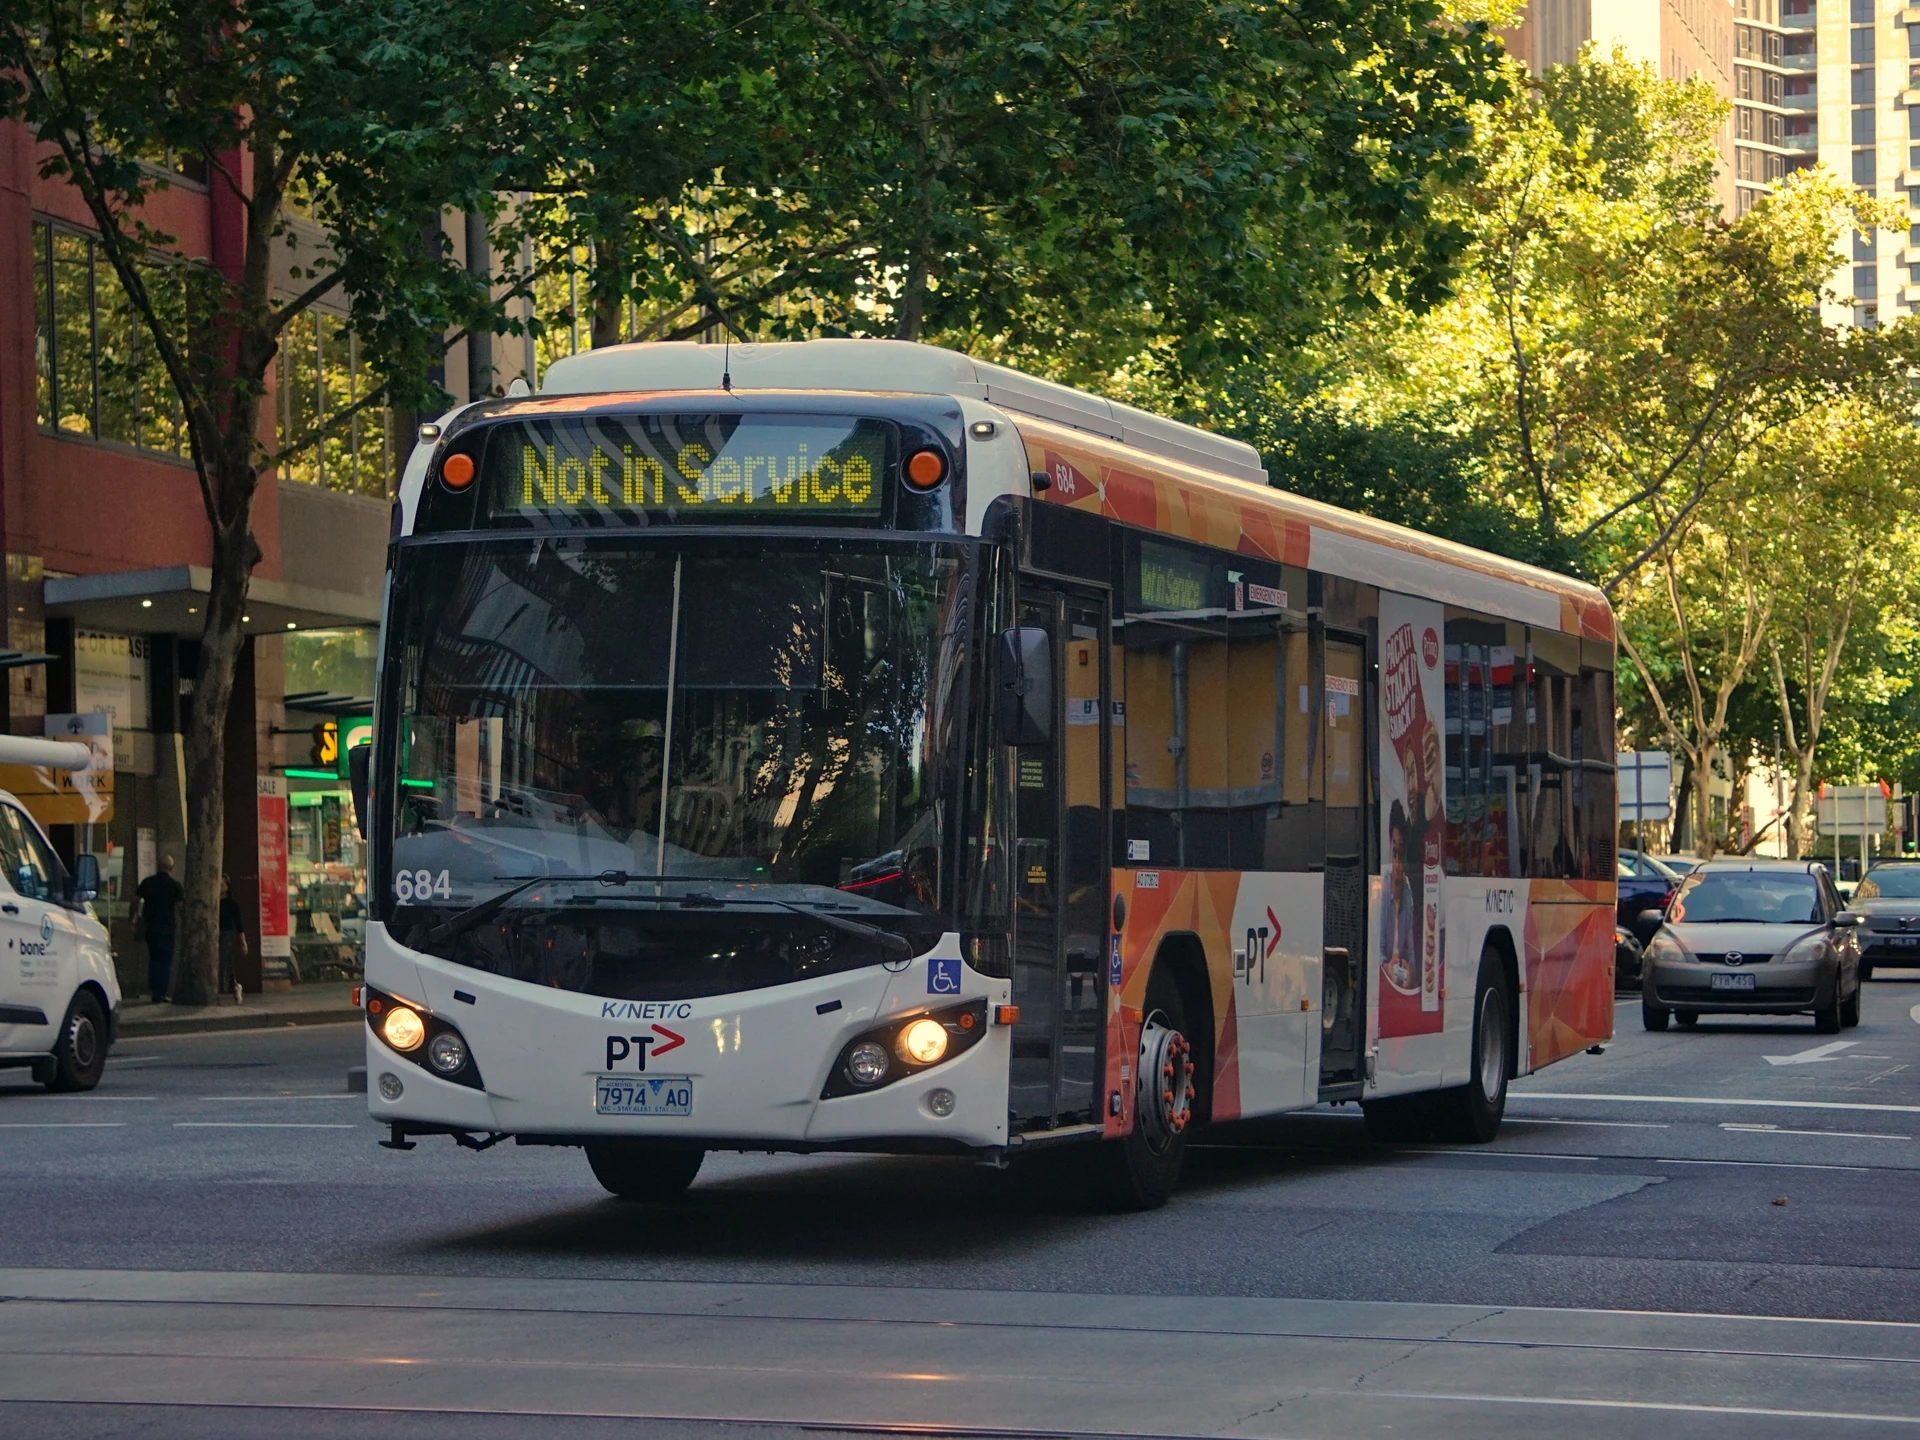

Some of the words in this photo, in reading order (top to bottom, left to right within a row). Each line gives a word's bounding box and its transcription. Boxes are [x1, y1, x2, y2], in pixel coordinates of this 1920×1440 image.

[523, 444, 609, 504] Not
[623, 444, 663, 504] in
[677, 443, 873, 504] Service
[1055, 464, 1076, 495] 684
[1250, 586, 1276, 604] EMERGENCY
[1385, 628, 1406, 671] PACK
[1385, 656, 1412, 712] STACK
[1389, 697, 1411, 740] SNACK
[62, 775, 106, 788] WORK
[258, 779, 276, 794] SALE
[395, 869, 452, 900] 684
[19, 938, 46, 956] bone
[599, 1087, 646, 1106] 7974
